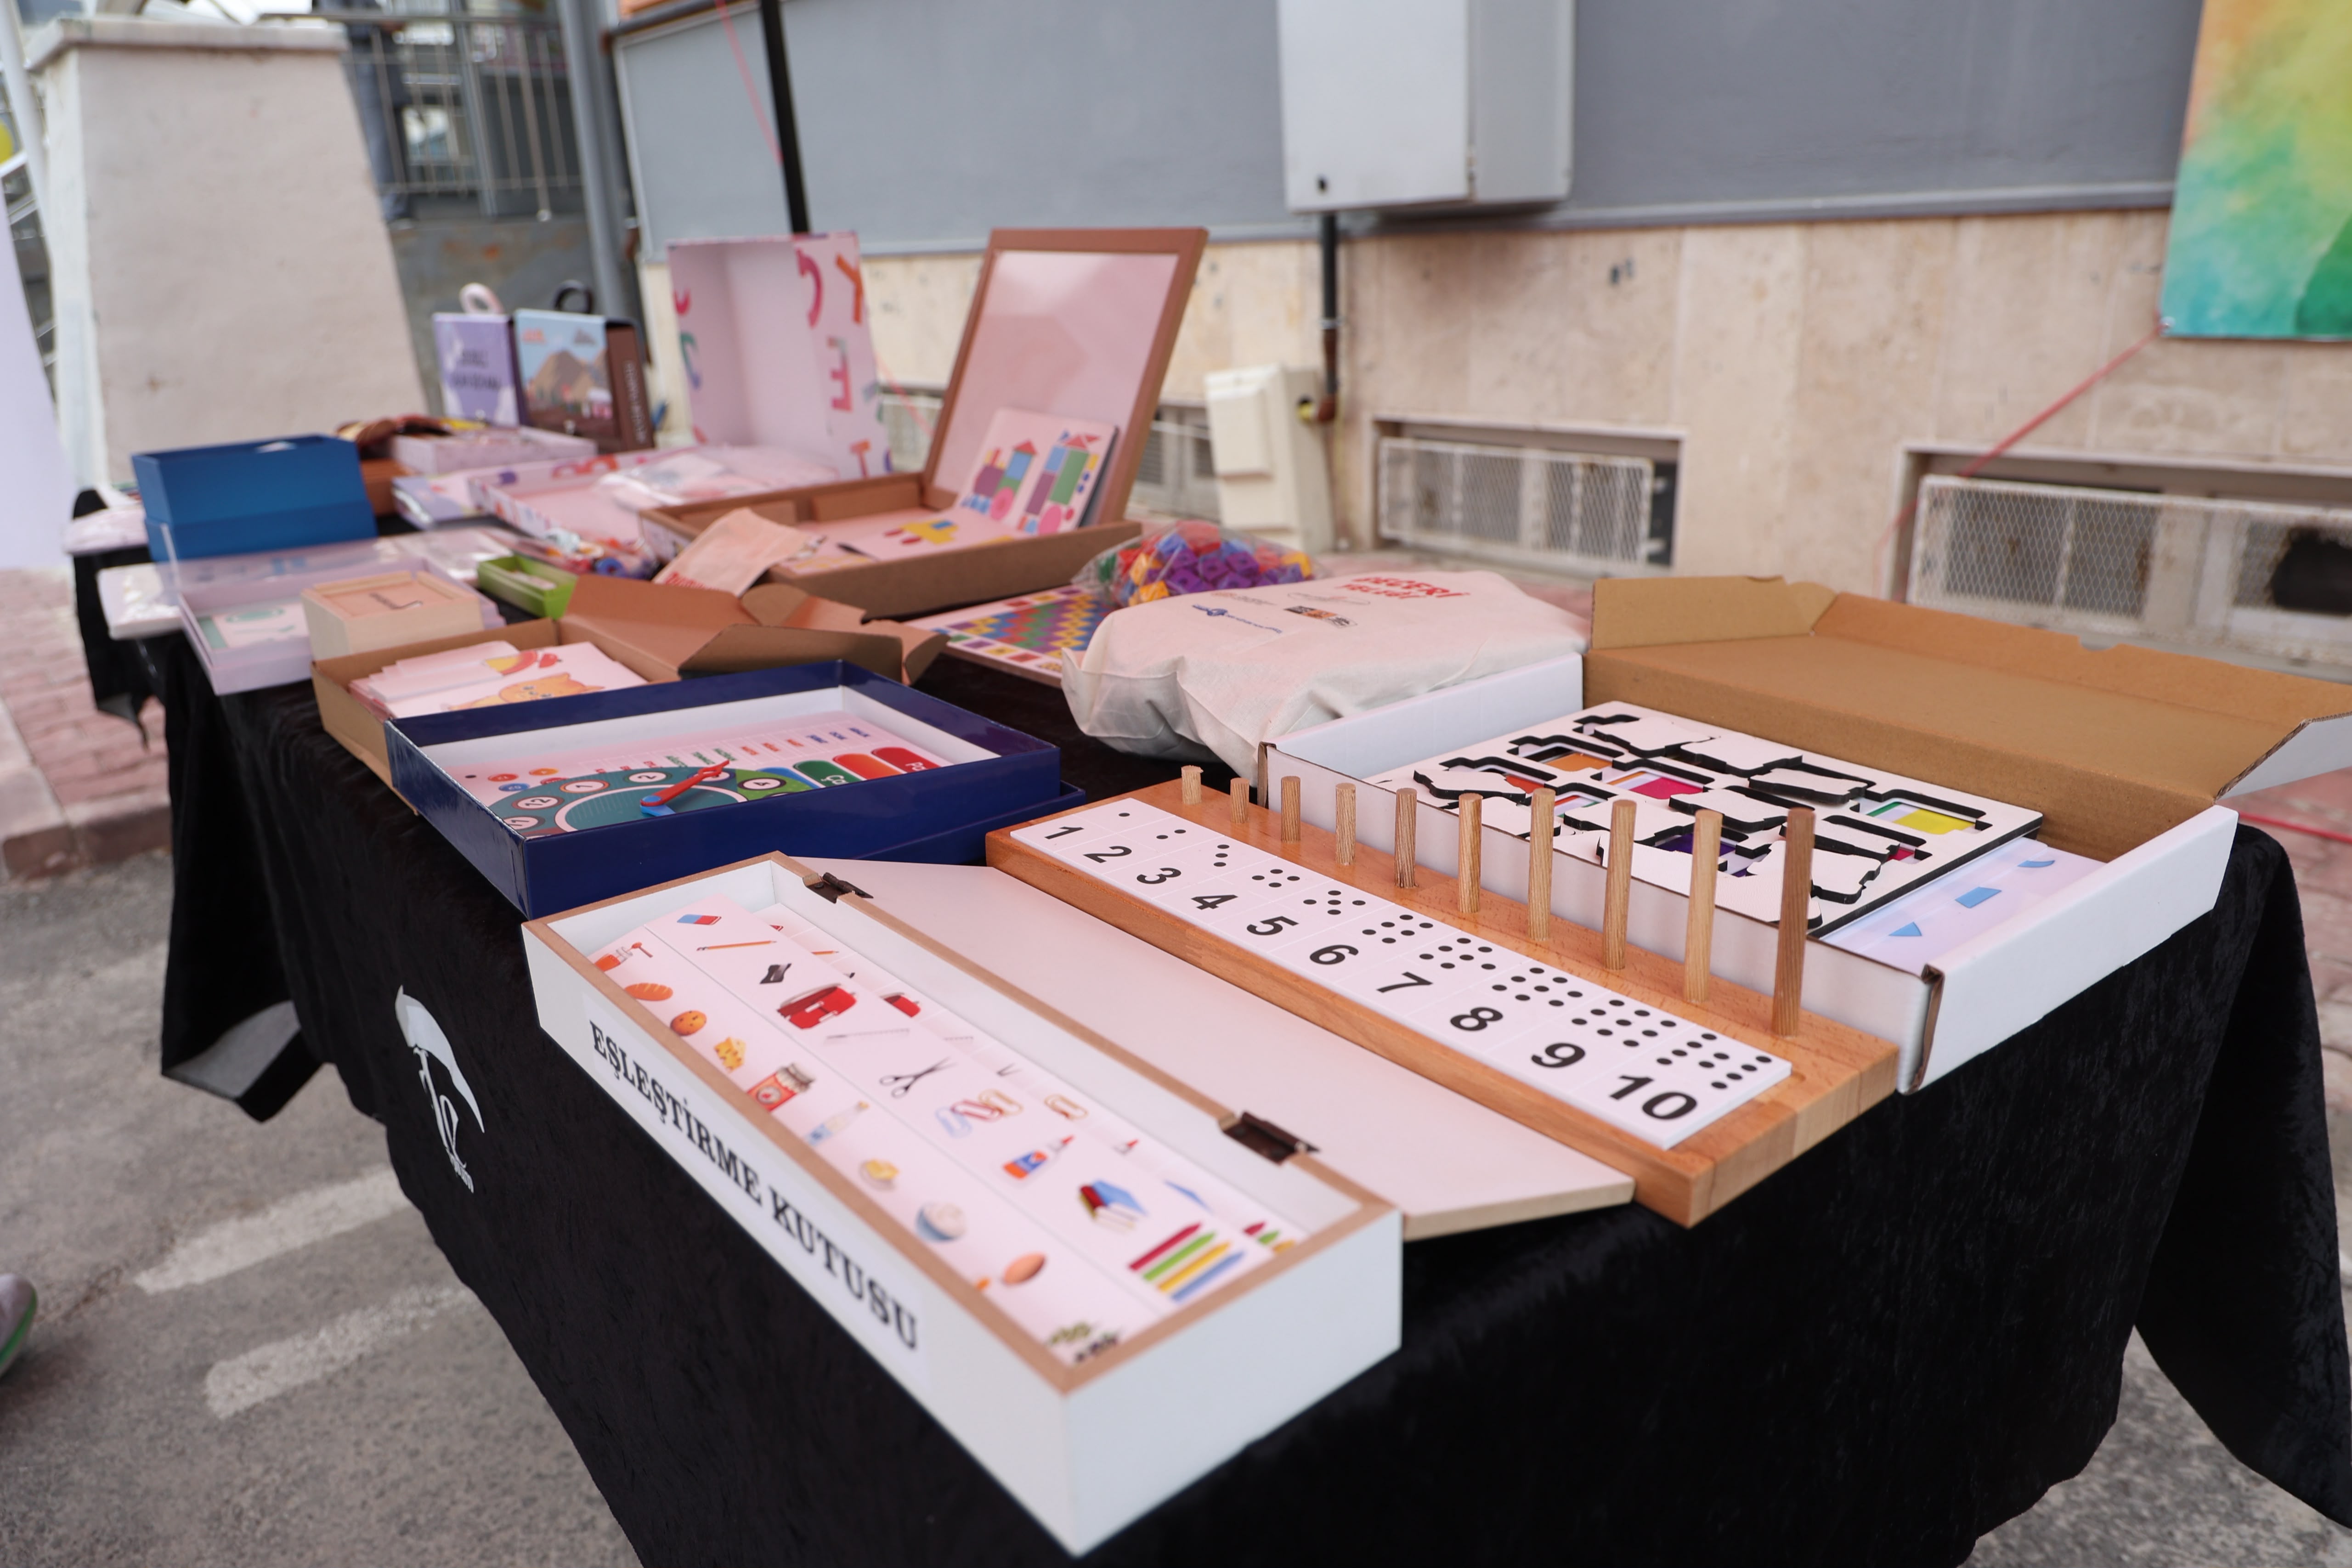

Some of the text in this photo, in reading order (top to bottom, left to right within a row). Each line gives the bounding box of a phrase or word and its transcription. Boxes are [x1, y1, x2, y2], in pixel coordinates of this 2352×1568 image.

[524, 798, 551, 807] 12
[1044, 825, 1085, 840] 1
[1083, 845, 1132, 863] 2
[1136, 867, 1182, 885] 3
[1190, 893, 1239, 910] 4
[1246, 915, 1299, 936] 5
[1309, 944, 1359, 965] 6
[1376, 971, 1434, 994] 7
[1450, 1006, 1504, 1032] 8
[1530, 1042, 1586, 1068] 9
[1609, 1073, 1698, 1121] 10
[589, 1020, 918, 1351] EŞLEŞTİRME KUTUSU
